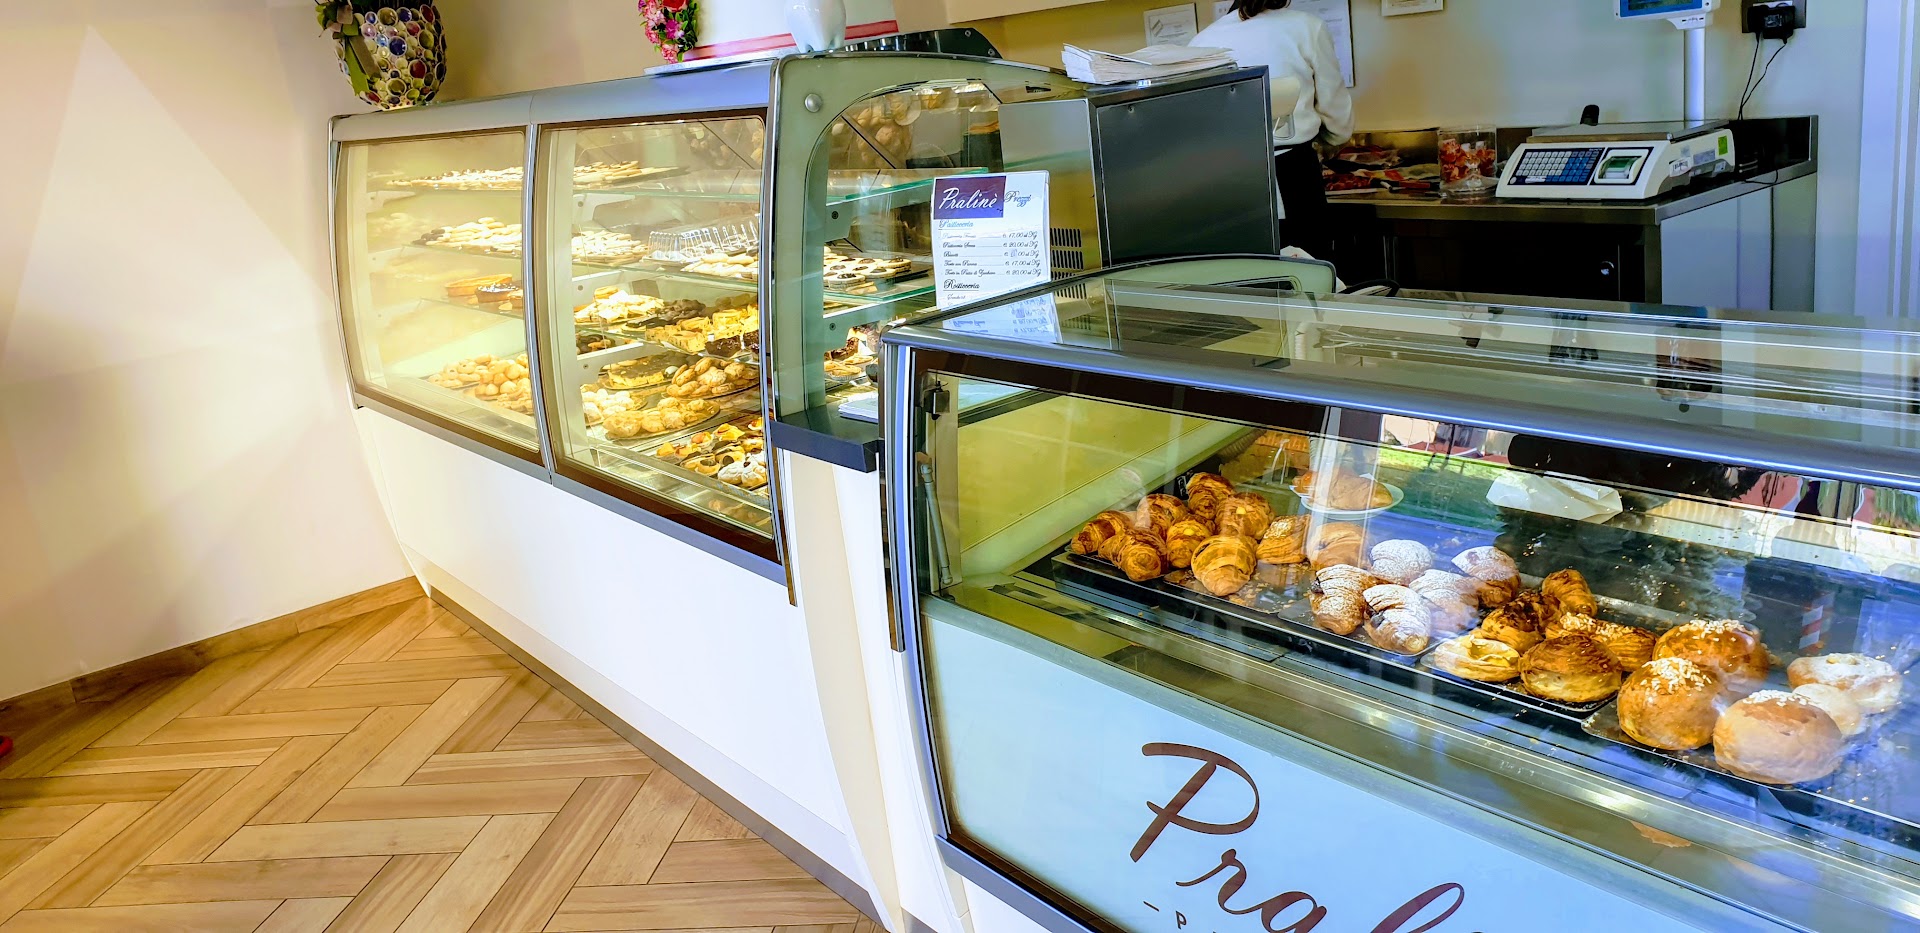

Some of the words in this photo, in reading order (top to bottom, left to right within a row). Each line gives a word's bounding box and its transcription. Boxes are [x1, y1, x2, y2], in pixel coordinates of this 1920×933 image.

[938, 187, 998, 210] Pralinè
[1004, 190, 1032, 208] Prezzi
[1130, 742, 1483, 933] Pral
